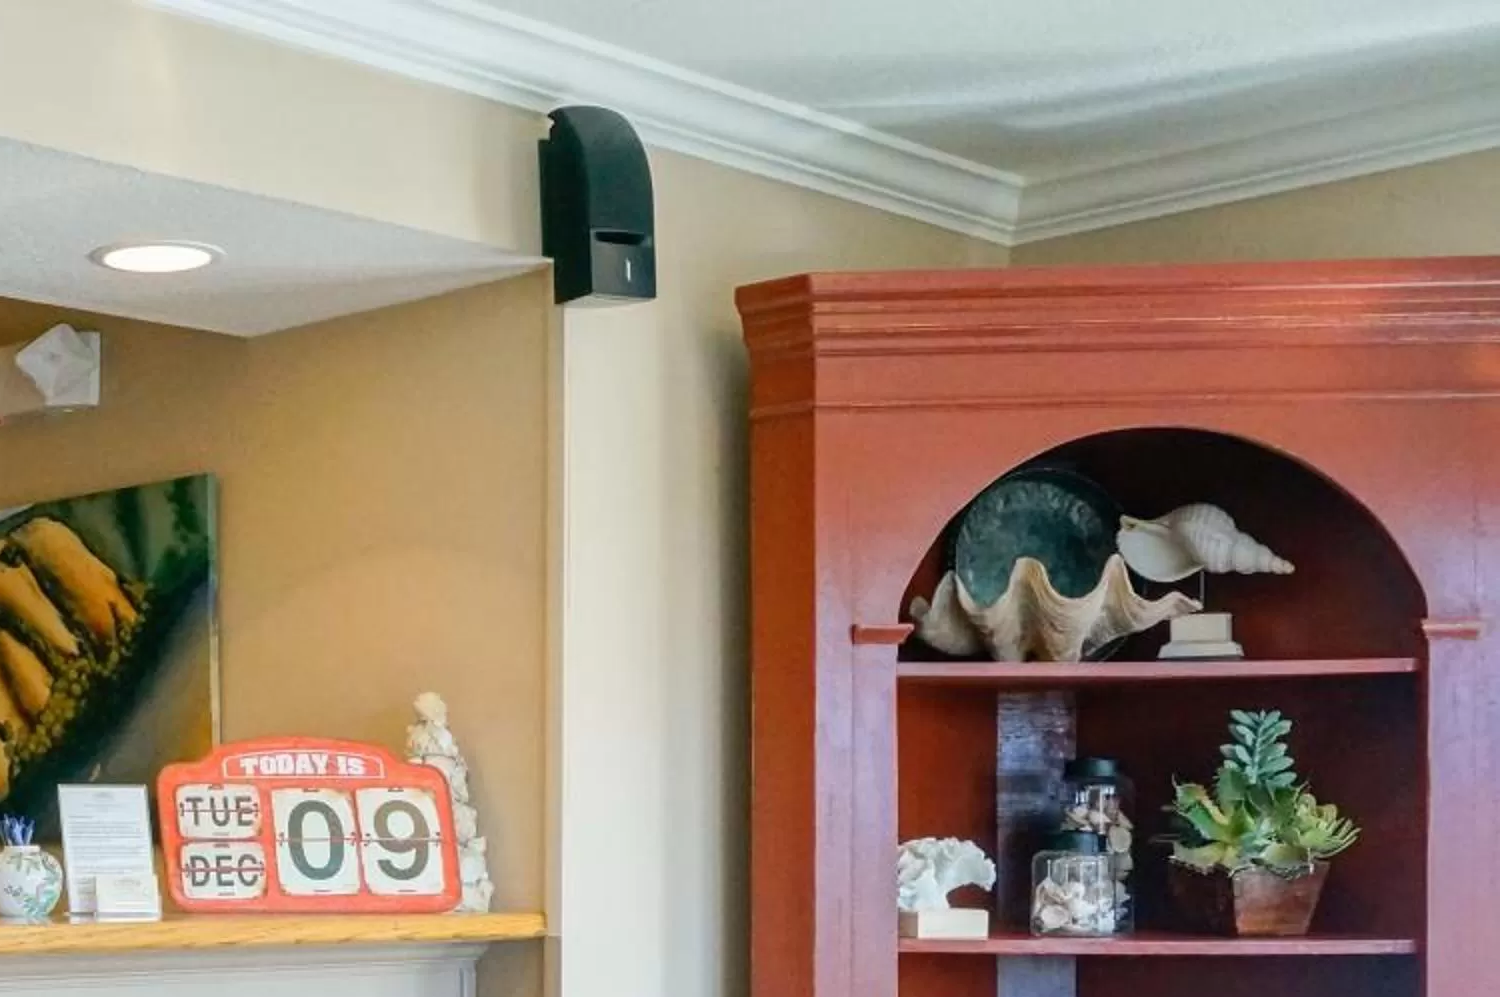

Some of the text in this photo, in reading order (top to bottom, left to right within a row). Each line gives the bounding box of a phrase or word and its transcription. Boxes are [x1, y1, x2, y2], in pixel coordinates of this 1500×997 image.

[240, 752, 366, 776] TODAY IS
[185, 795, 254, 827] TUE
[189, 853, 260, 888] DEC
